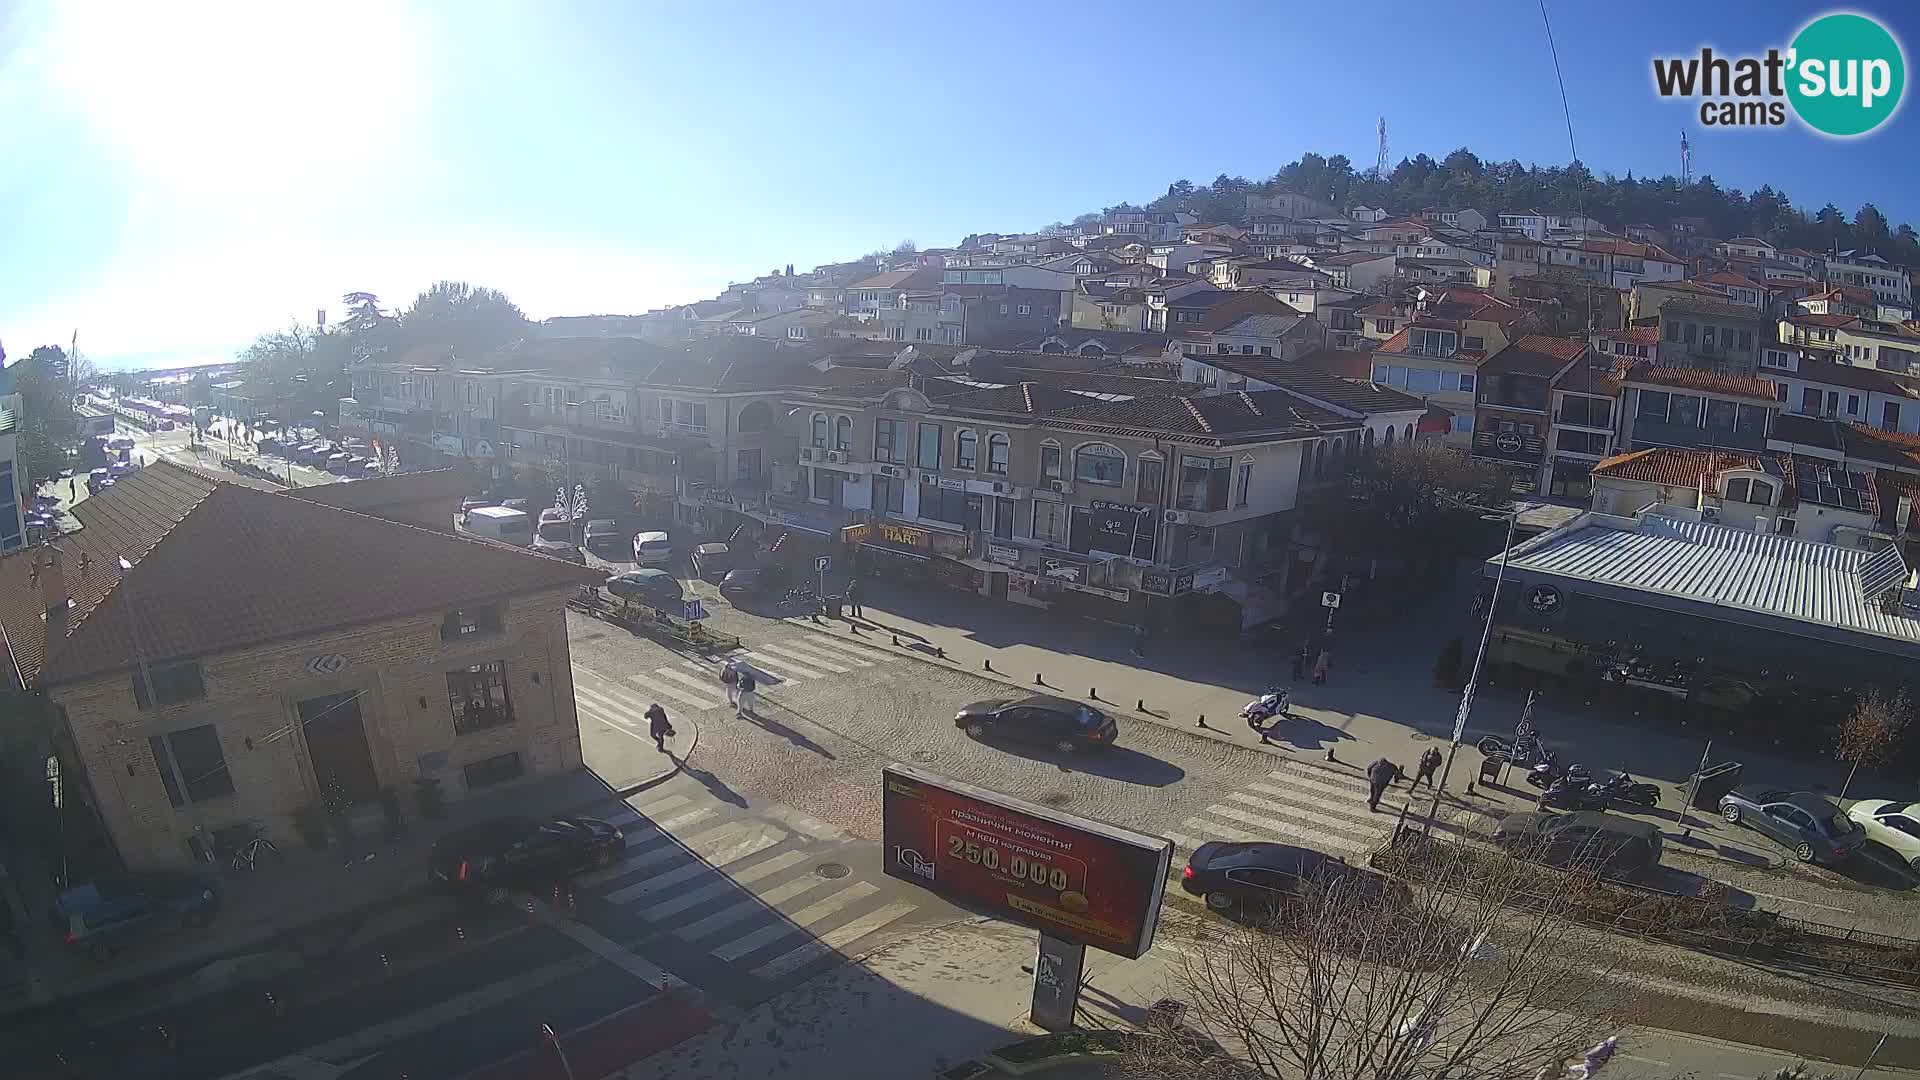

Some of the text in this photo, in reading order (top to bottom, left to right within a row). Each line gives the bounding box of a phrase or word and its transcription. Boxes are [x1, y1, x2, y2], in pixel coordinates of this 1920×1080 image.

[819, 559, 827, 570] P
[951, 808, 1012, 834] празнични
[1014, 828, 1073, 851] моменти!
[977, 831, 999, 845] КЕШ
[1000, 839, 1053, 861] наградува
[948, 836, 1067, 891] 250.000
